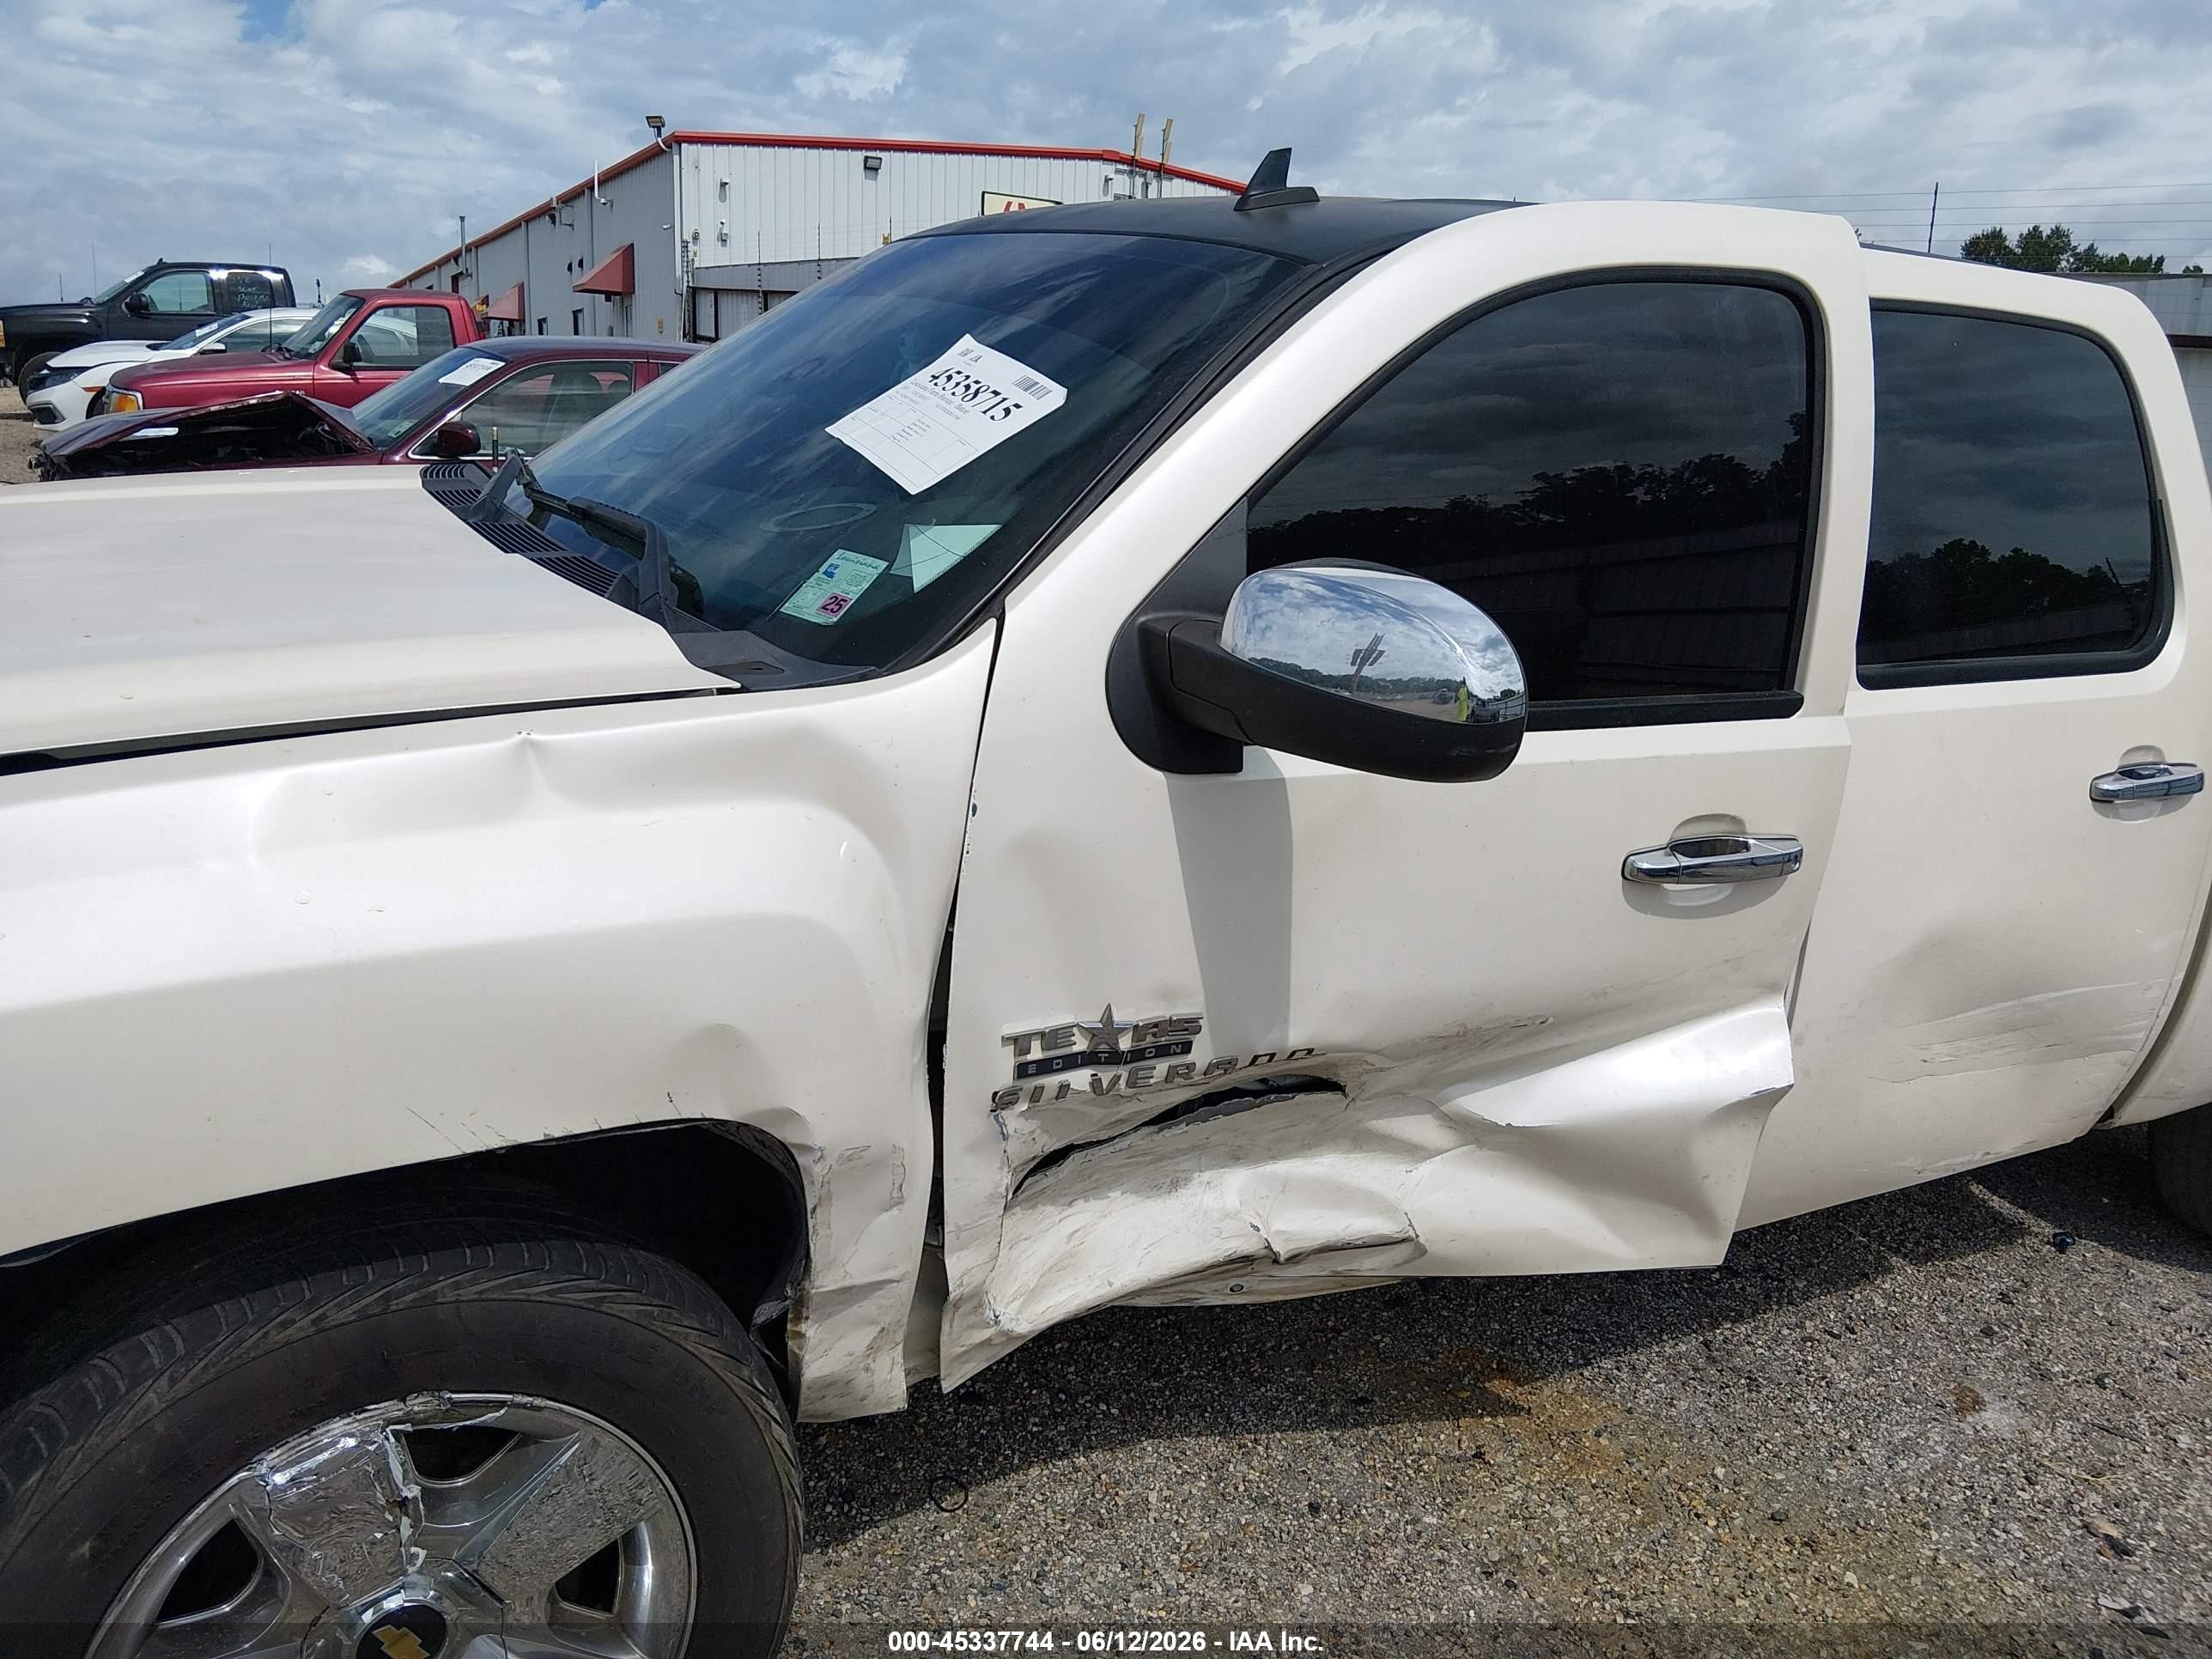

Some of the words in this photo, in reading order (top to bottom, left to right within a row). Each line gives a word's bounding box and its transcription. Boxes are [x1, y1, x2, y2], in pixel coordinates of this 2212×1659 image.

[928, 368, 1024, 422] 45358715
[836, 551, 881, 570] Louisiana
[821, 595, 848, 614] 25
[1027, 1043, 1183, 1074] EDITION
